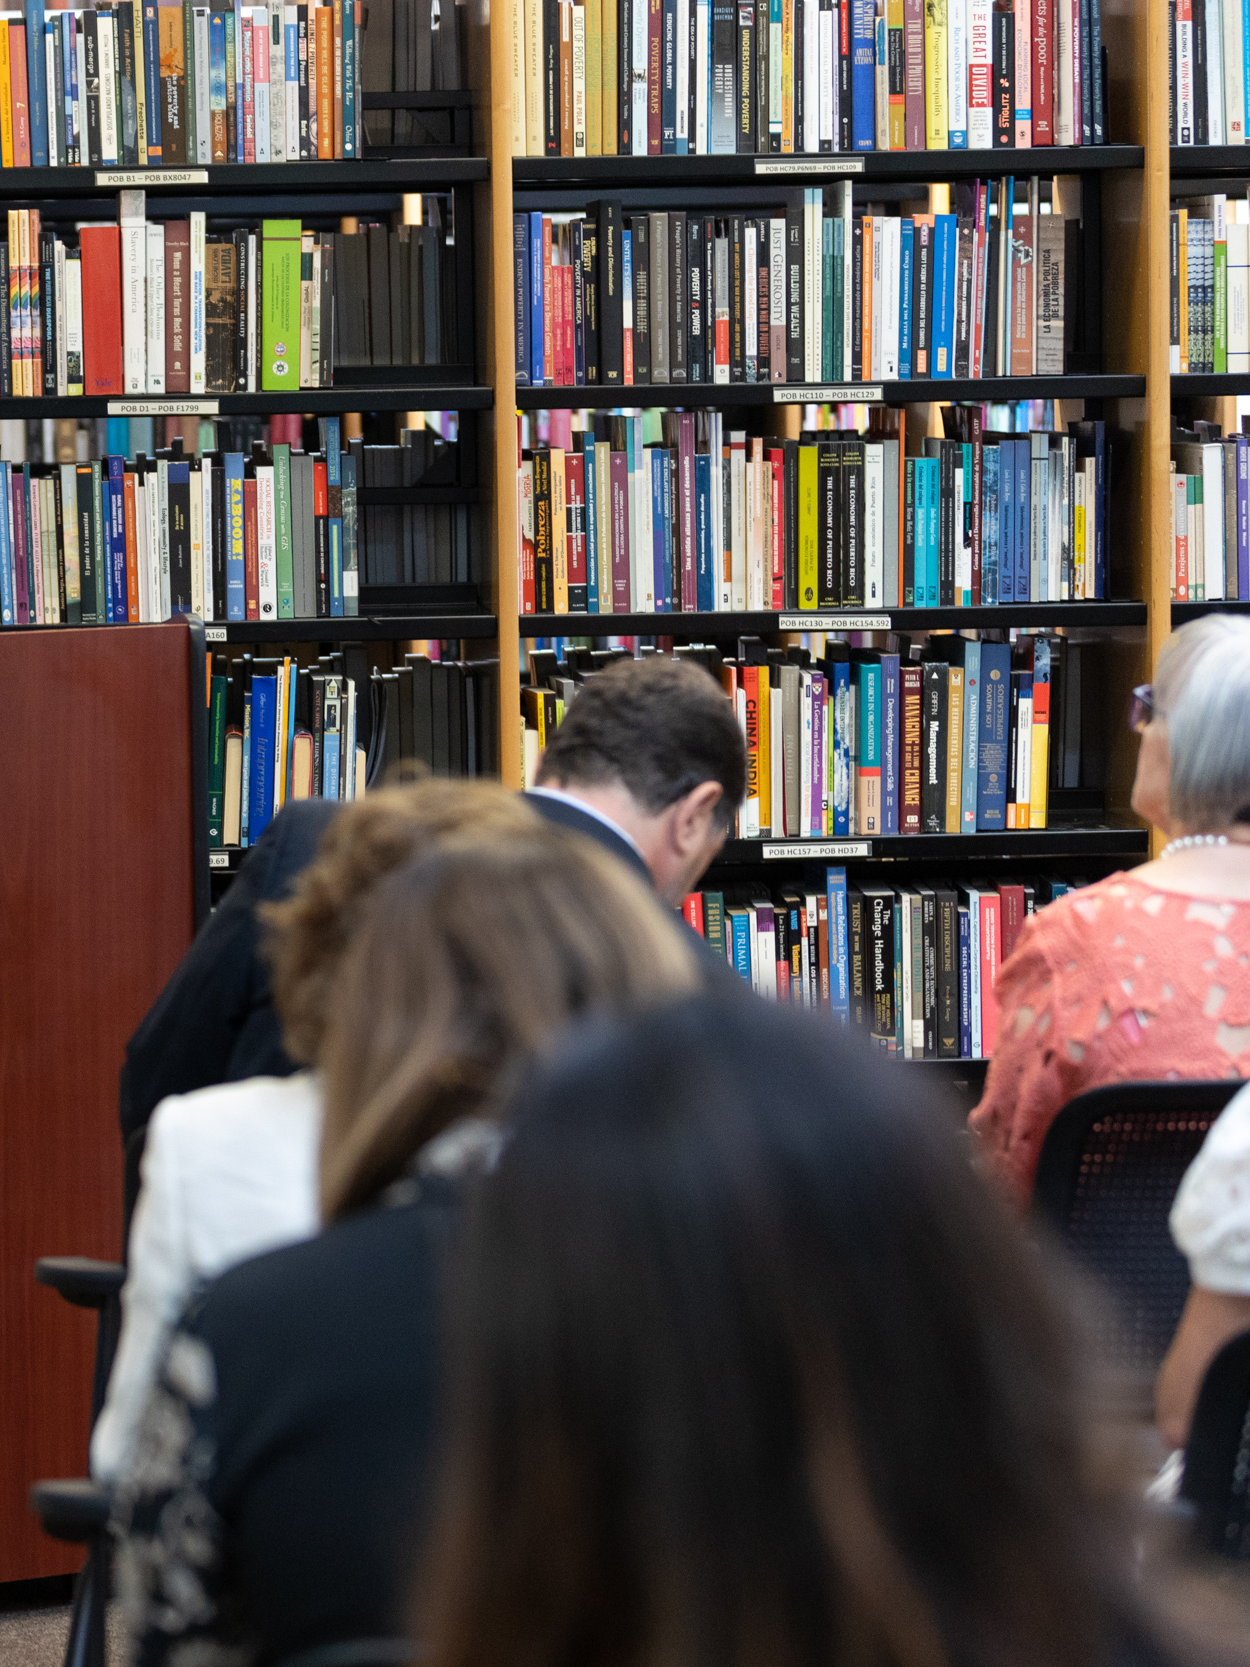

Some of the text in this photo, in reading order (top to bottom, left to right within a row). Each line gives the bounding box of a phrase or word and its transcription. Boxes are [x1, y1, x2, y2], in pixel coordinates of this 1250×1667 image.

[87, 36, 96, 73] sub-merge
[651, 37, 659, 114] POVERTY TRAPS
[908, 19, 922, 95] THE ROAD TO POVERTY
[972, 13, 987, 105] THE GREAT DIVIDE
[741, 98, 749, 134] POVERTY
[1001, 93, 1009, 128] STIGLITZ
[130, 231, 139, 313] Slavery in America
[173, 252, 182, 269] When
[771, 227, 782, 323] JUST GENEROSITY
[173, 277, 182, 296] Heart
[691, 268, 700, 300] POVERTY
[790, 265, 799, 338] BUILDING WEALTH
[0, 284, 8, 369] The Disuniting of America
[173, 298, 182, 316] Turns
[173, 318, 182, 333] Rock
[691, 310, 700, 335] POWER
[173, 335, 182, 351] Solid
[231, 478, 243, 560] KABOOM!
[826, 529, 833, 539] OF
[849, 527, 856, 537] OF
[867, 673, 875, 760] RESEARCH IN ORGANIZATIONS
[968, 694, 977, 768] ADMINISTRACIÓN
[746, 699, 757, 797] CHINA INDIA
[905, 695, 920, 806] MANAGING CHANGE
[928, 721, 939, 784] Management
[836, 891, 844, 915] Human
[837, 915, 845, 946] Relations
[873, 898, 884, 991] Change Handbook
[838, 954, 846, 999] Organizations
